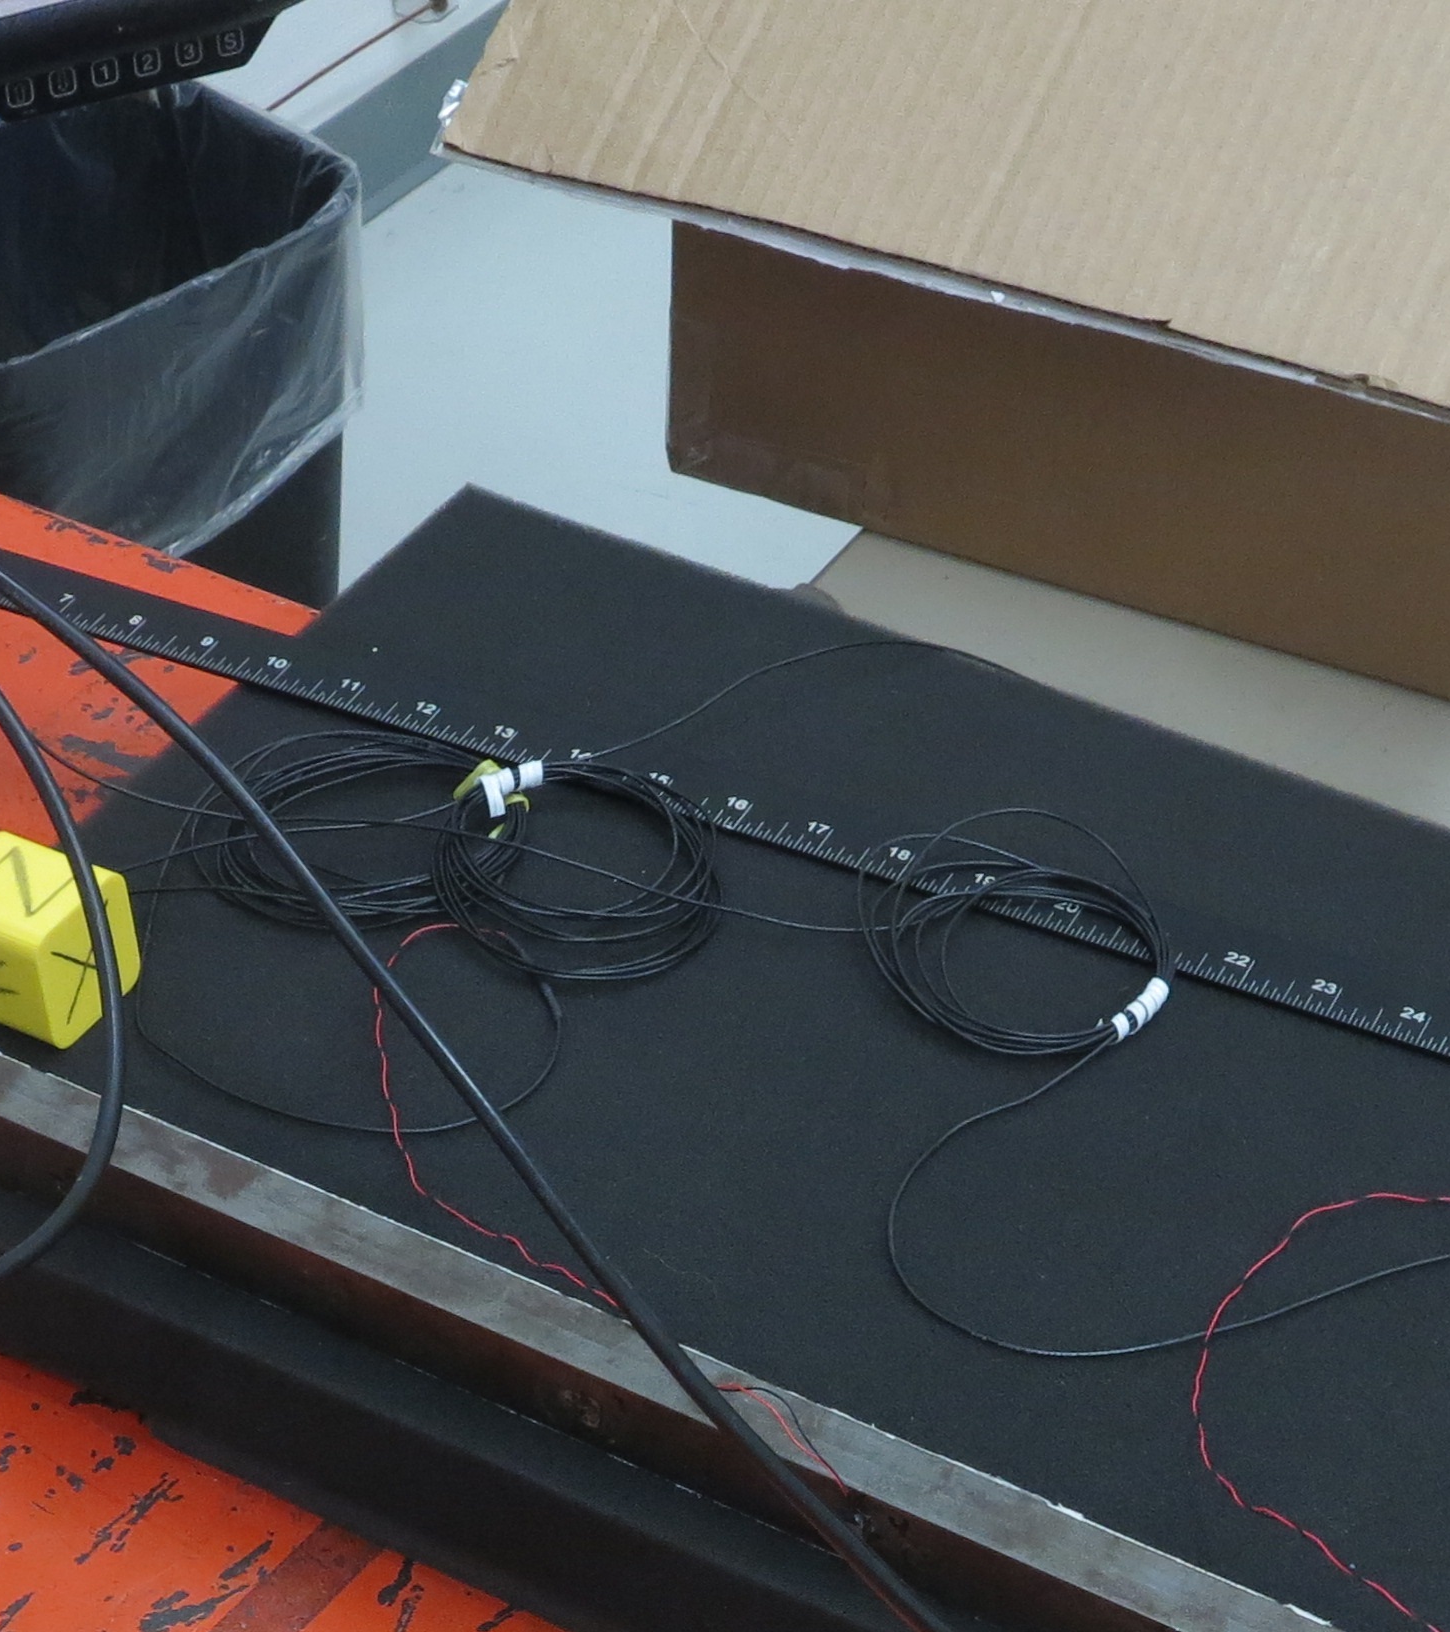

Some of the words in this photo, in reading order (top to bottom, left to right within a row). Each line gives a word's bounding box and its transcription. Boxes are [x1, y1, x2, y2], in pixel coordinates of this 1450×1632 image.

[100, 66, 110, 82] 1
[141, 53, 154, 71] 2
[183, 43, 195, 60] 3
[224, 32, 237, 50] S
[128, 614, 143, 626] 8
[200, 635, 214, 648] 9
[267, 656, 288, 670] 10
[340, 677, 361, 692] 11
[416, 701, 437, 715] 12
[494, 725, 515, 739] 13
[727, 796, 749, 811] 16
[807, 821, 831, 836] 17
[889, 846, 911, 861] 18
[1224, 951, 1251, 968] 22
[1312, 978, 1338, 995] 23
[1400, 1006, 1427, 1023] 24
